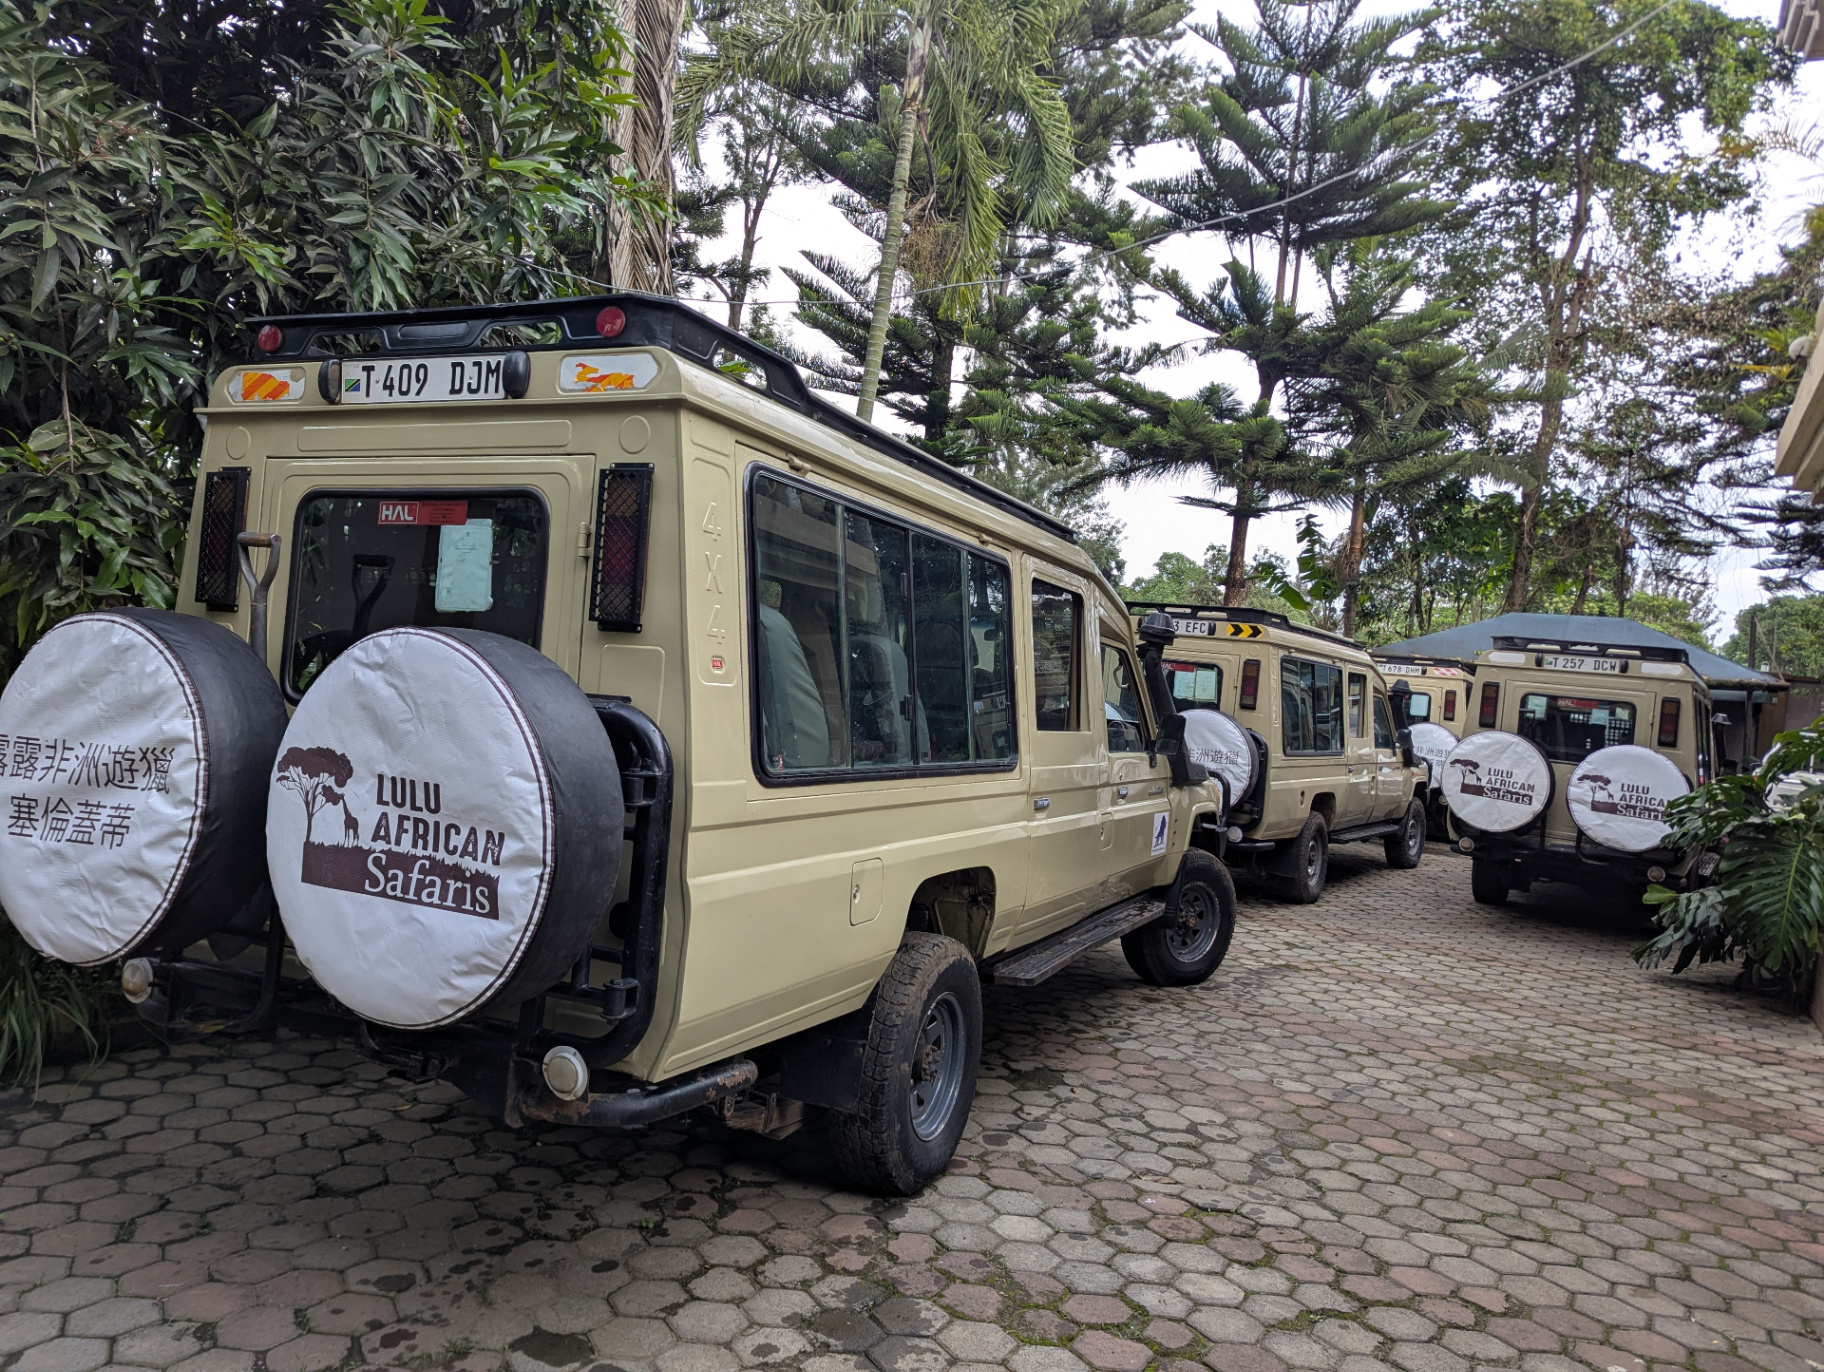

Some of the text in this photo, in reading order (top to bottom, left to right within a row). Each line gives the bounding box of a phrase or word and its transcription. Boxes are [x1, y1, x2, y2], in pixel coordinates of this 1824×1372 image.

[361, 359, 502, 397] T 409 DJM
[381, 504, 414, 521] HAL
[1185, 621, 1206, 634] EFC
[1387, 665, 1402, 673] 678
[1552, 657, 1617, 672] T 257 DCW
[1487, 767, 1513, 779] LULU
[1486, 776, 1535, 793] AFRICAN
[1620, 782, 1650, 795] LULU
[376, 773, 441, 814] LULU
[1482, 786, 1530, 806] Safaris
[1619, 793, 1671, 809] AFRICA
[1616, 802, 1664, 821] Safari
[8, 793, 135, 849] 塞倫蓋蒂
[371, 811, 505, 866] AFRICAN
[364, 852, 490, 914] Safaris
